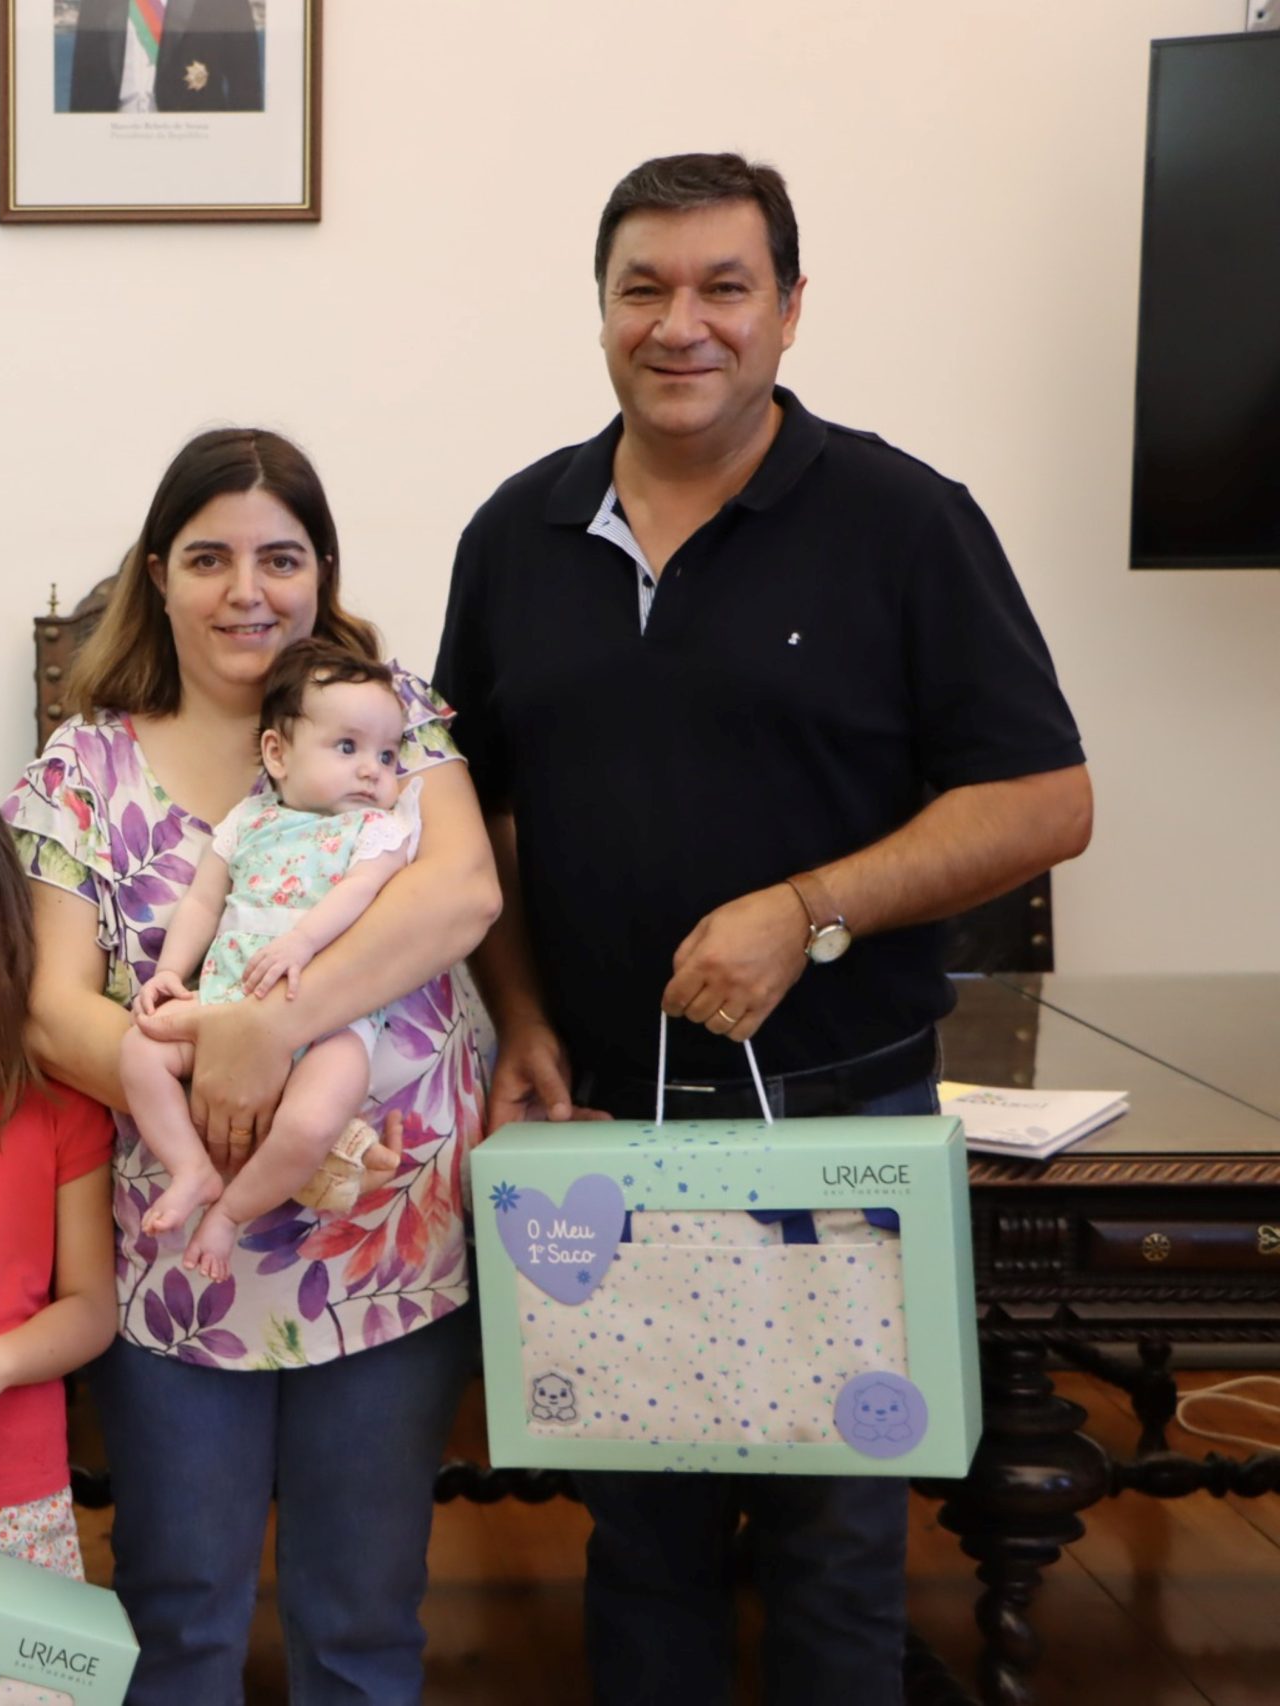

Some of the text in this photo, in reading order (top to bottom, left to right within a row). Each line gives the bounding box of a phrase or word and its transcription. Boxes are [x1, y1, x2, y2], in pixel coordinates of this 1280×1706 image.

[822, 1164, 911, 1189] URIAGE
[527, 1218, 596, 1239] O Meu
[547, 1243, 597, 1264] Saco
[18, 1637, 101, 1677] URIAGE
